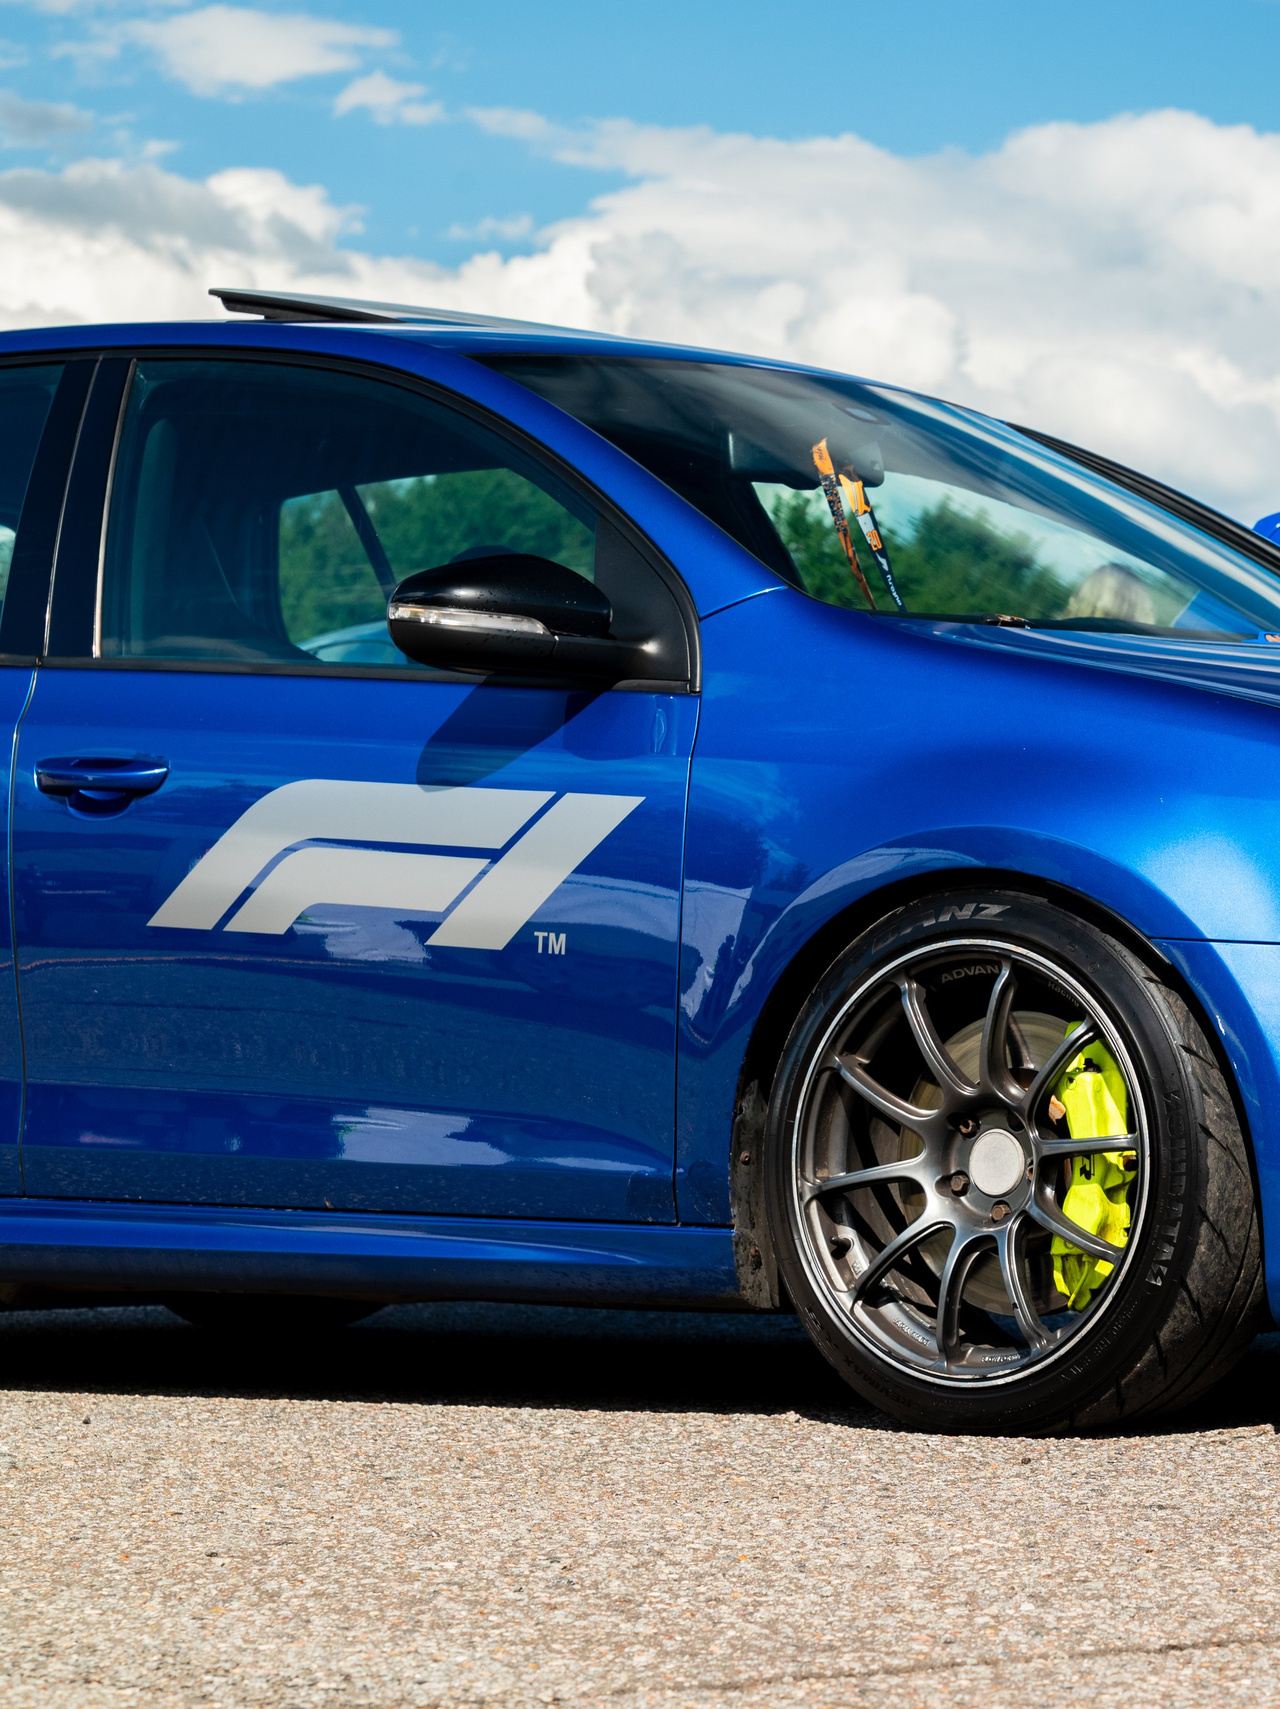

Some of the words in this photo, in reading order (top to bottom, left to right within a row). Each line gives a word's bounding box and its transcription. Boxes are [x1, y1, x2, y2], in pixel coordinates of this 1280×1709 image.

[867, 530, 882, 551] 20
[534, 931, 567, 955] TM
[940, 964, 1000, 985] ADVAN
